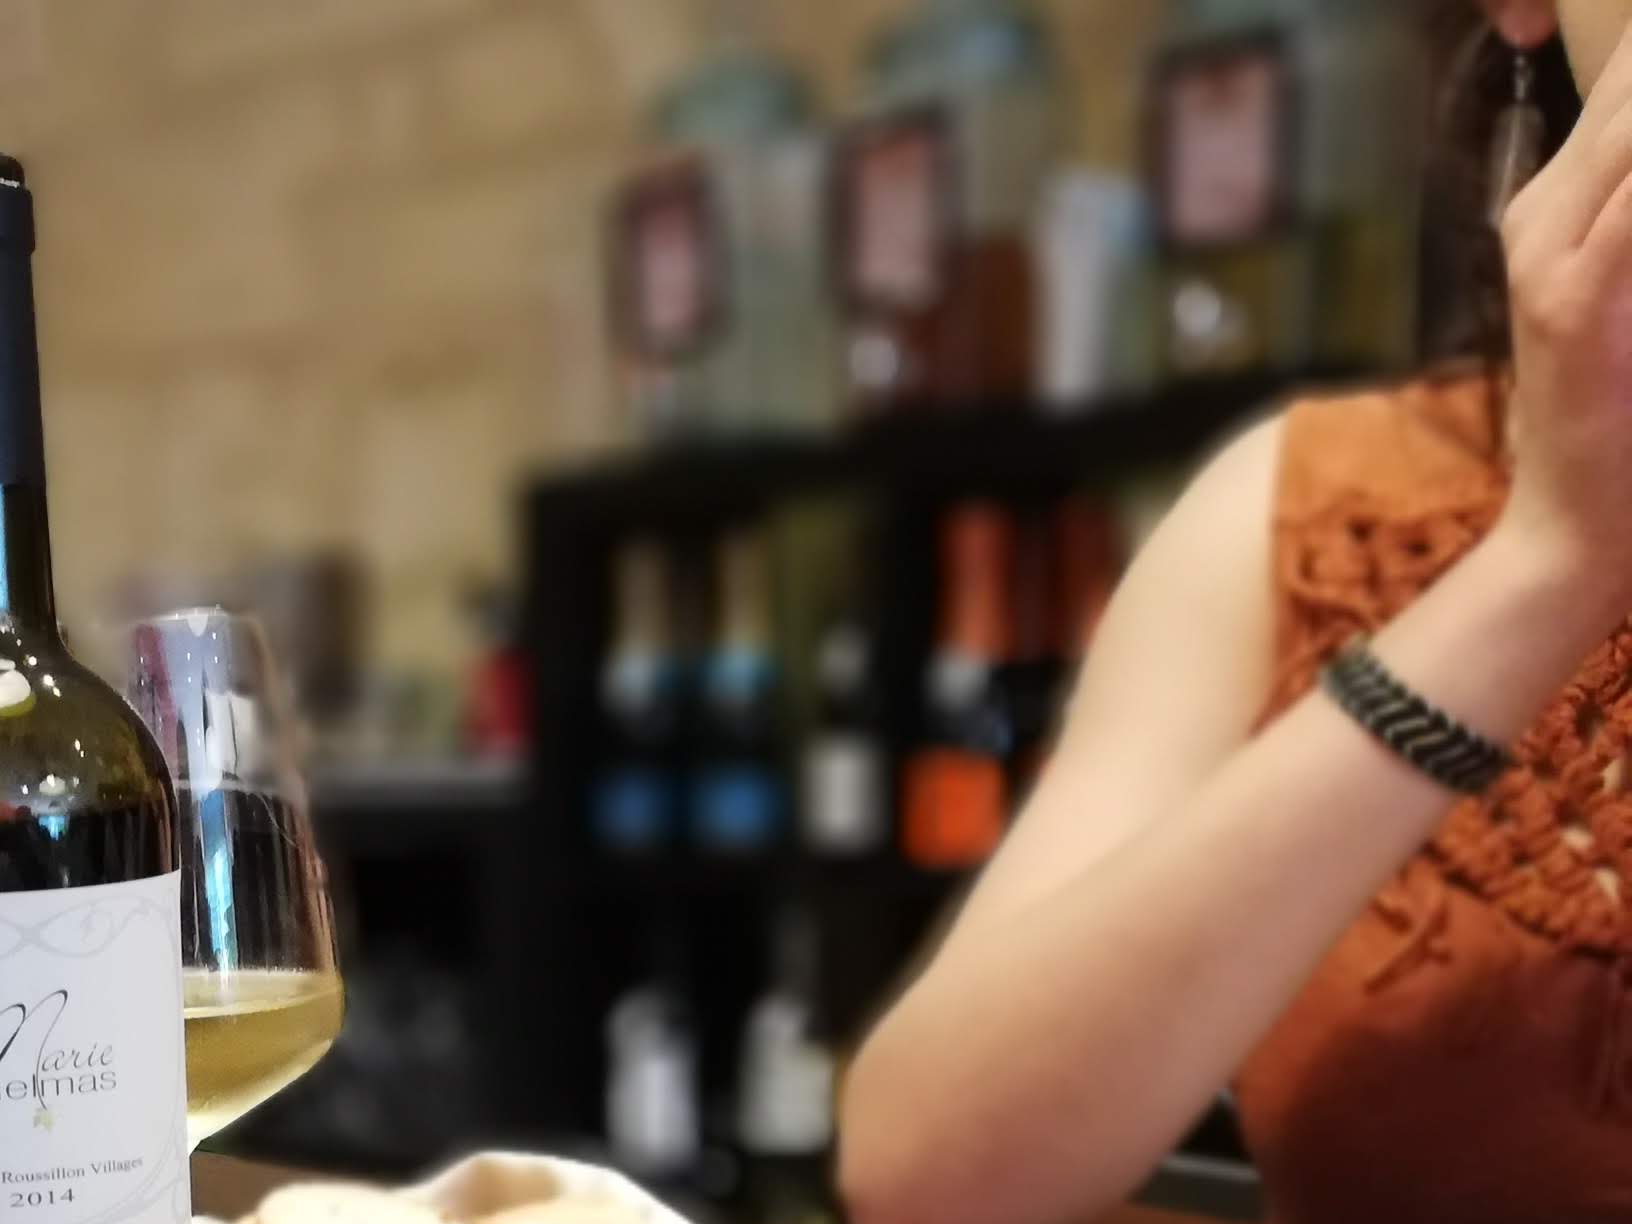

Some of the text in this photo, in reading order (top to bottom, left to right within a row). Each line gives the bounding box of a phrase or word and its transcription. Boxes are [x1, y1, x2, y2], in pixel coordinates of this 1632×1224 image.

[1, 1166, 86, 1184] Roussillon
[90, 1156, 144, 1174] Villages
[10, 1188, 76, 1207] 2014
